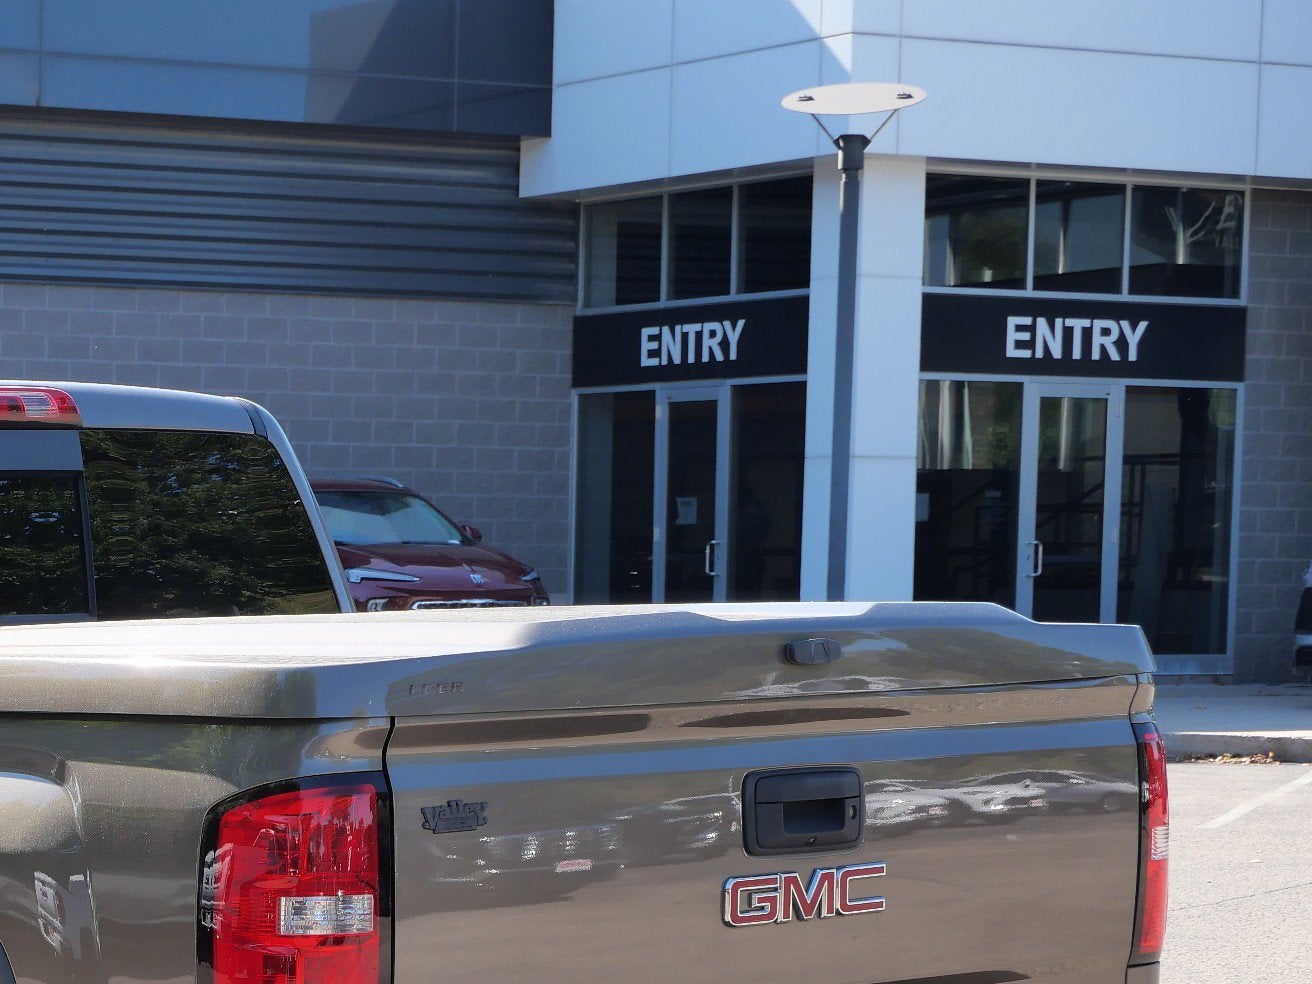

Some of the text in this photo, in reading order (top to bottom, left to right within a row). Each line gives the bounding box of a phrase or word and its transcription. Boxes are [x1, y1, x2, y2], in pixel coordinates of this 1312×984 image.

[641, 319, 746, 367] ENTRY
[1006, 316, 1149, 361] ENTRY
[723, 861, 886, 926] GMC
